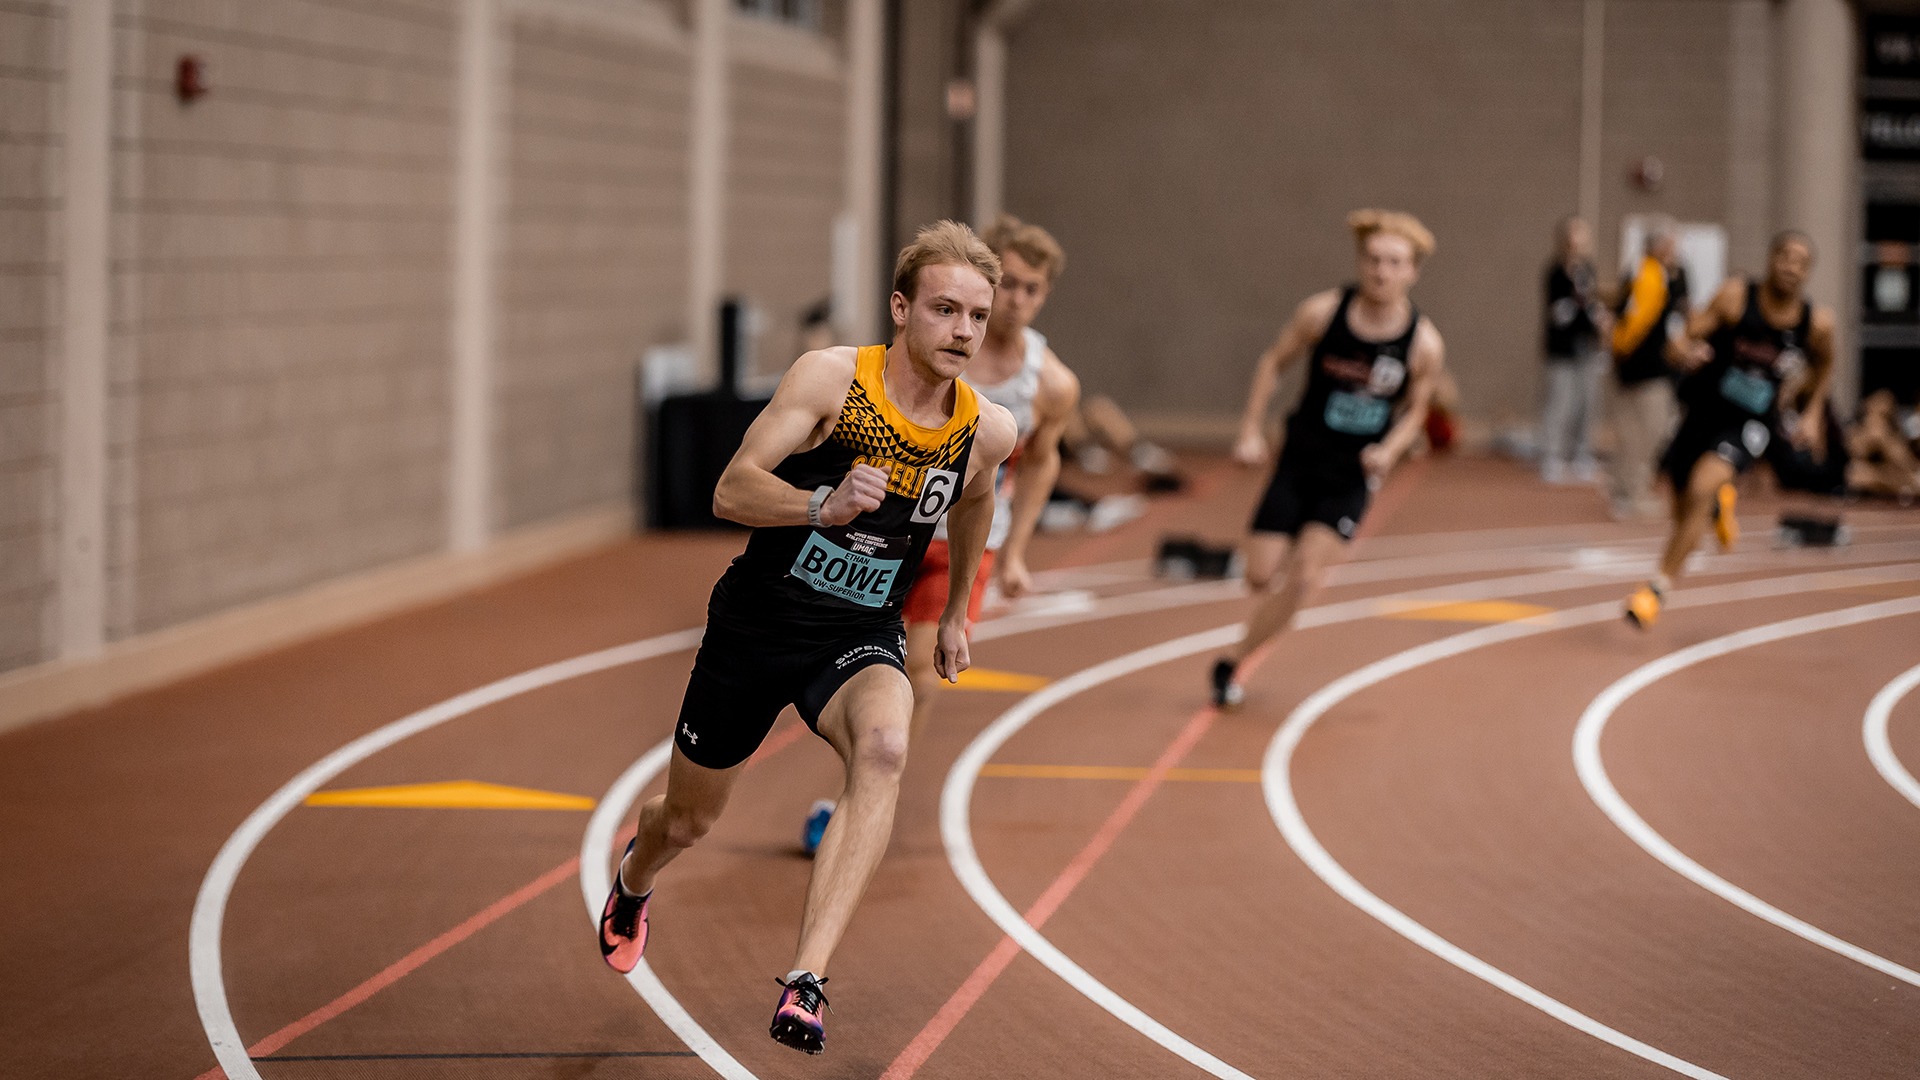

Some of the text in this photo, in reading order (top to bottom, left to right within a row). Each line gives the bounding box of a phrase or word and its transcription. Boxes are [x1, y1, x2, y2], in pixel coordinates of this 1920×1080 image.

[919, 474, 950, 518] 6
[844, 552, 870, 565] ETHAN
[852, 543, 875, 555] UMAC
[801, 544, 893, 595] BOWE
[813, 577, 866, 601] UW-SUPERIOR
